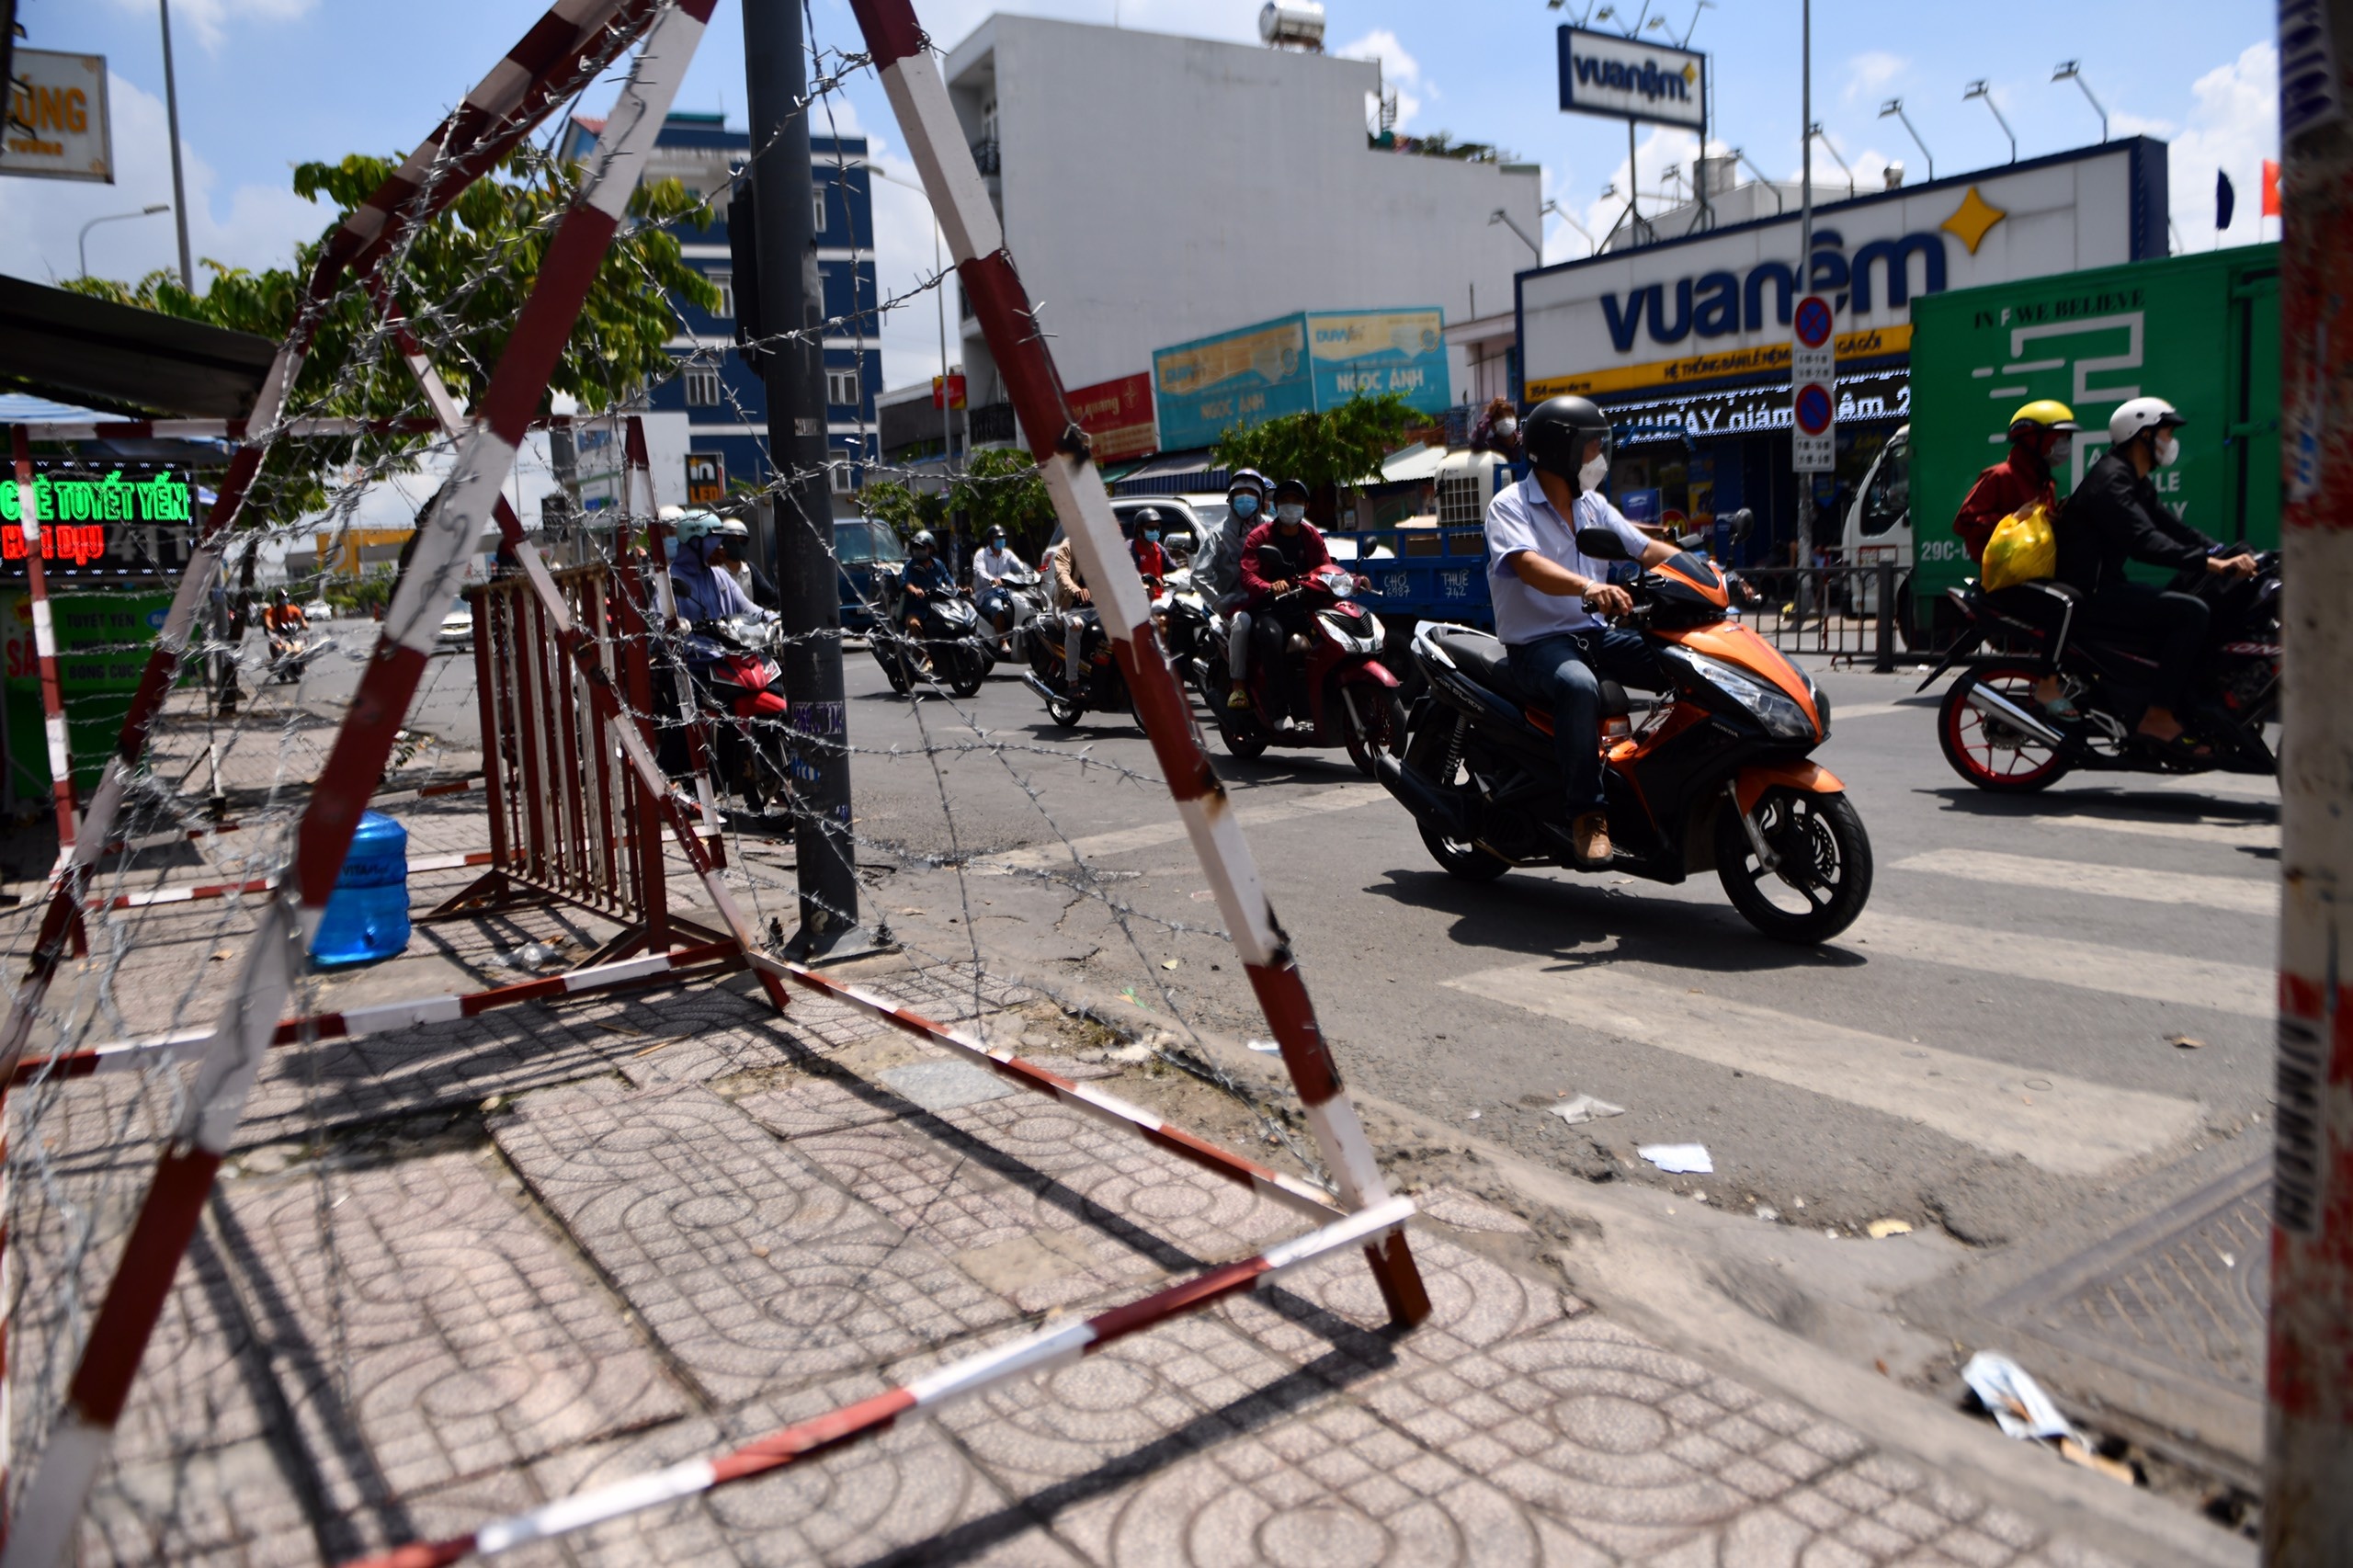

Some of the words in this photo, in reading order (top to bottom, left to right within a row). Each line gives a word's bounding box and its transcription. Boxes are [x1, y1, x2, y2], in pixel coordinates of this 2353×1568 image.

[1974, 311, 1995, 329] IN
[2001, 308, 2011, 326] F
[2017, 303, 2049, 323] WE
[2055, 289, 2146, 317] BELIEVE
[0, 473, 54, 521] CÈ
[53, 471, 135, 521] TUYẾT
[136, 471, 189, 521] YẾN
[691, 486, 720, 504] LED
